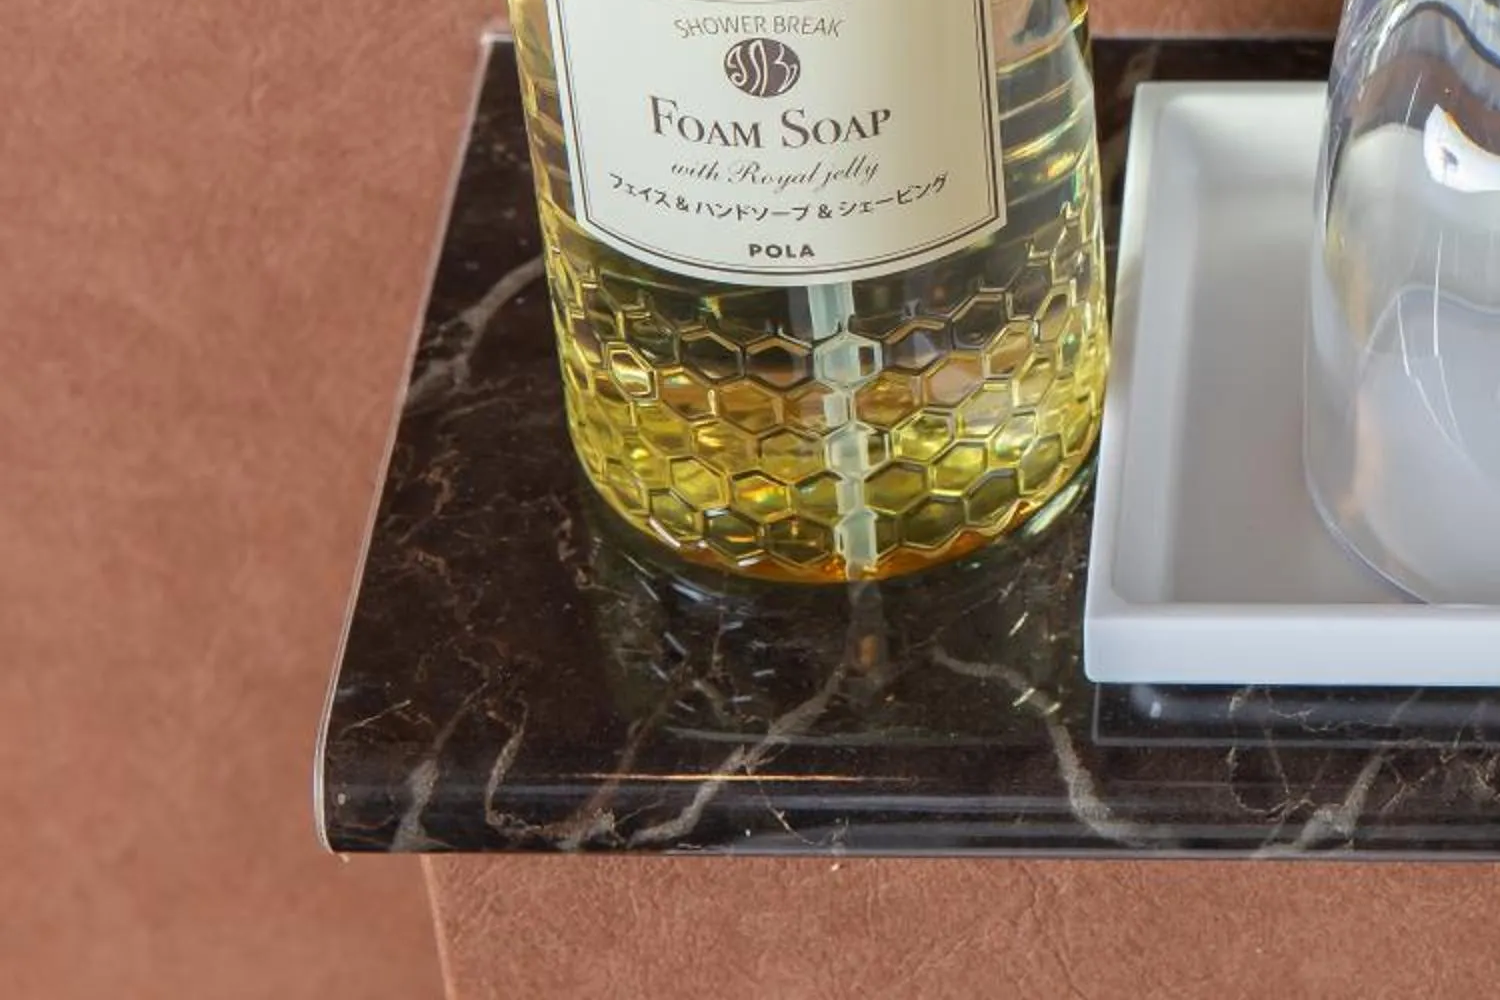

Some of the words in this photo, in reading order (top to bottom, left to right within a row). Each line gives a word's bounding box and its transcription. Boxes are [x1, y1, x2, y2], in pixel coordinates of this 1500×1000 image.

[673, 15, 765, 38] SHOWER
[773, 15, 847, 38] BREAK
[671, 160, 719, 181] with
[727, 160, 820, 193] Royal
[821, 153, 881, 188] jelly
[748, 242, 816, 259] POLA
